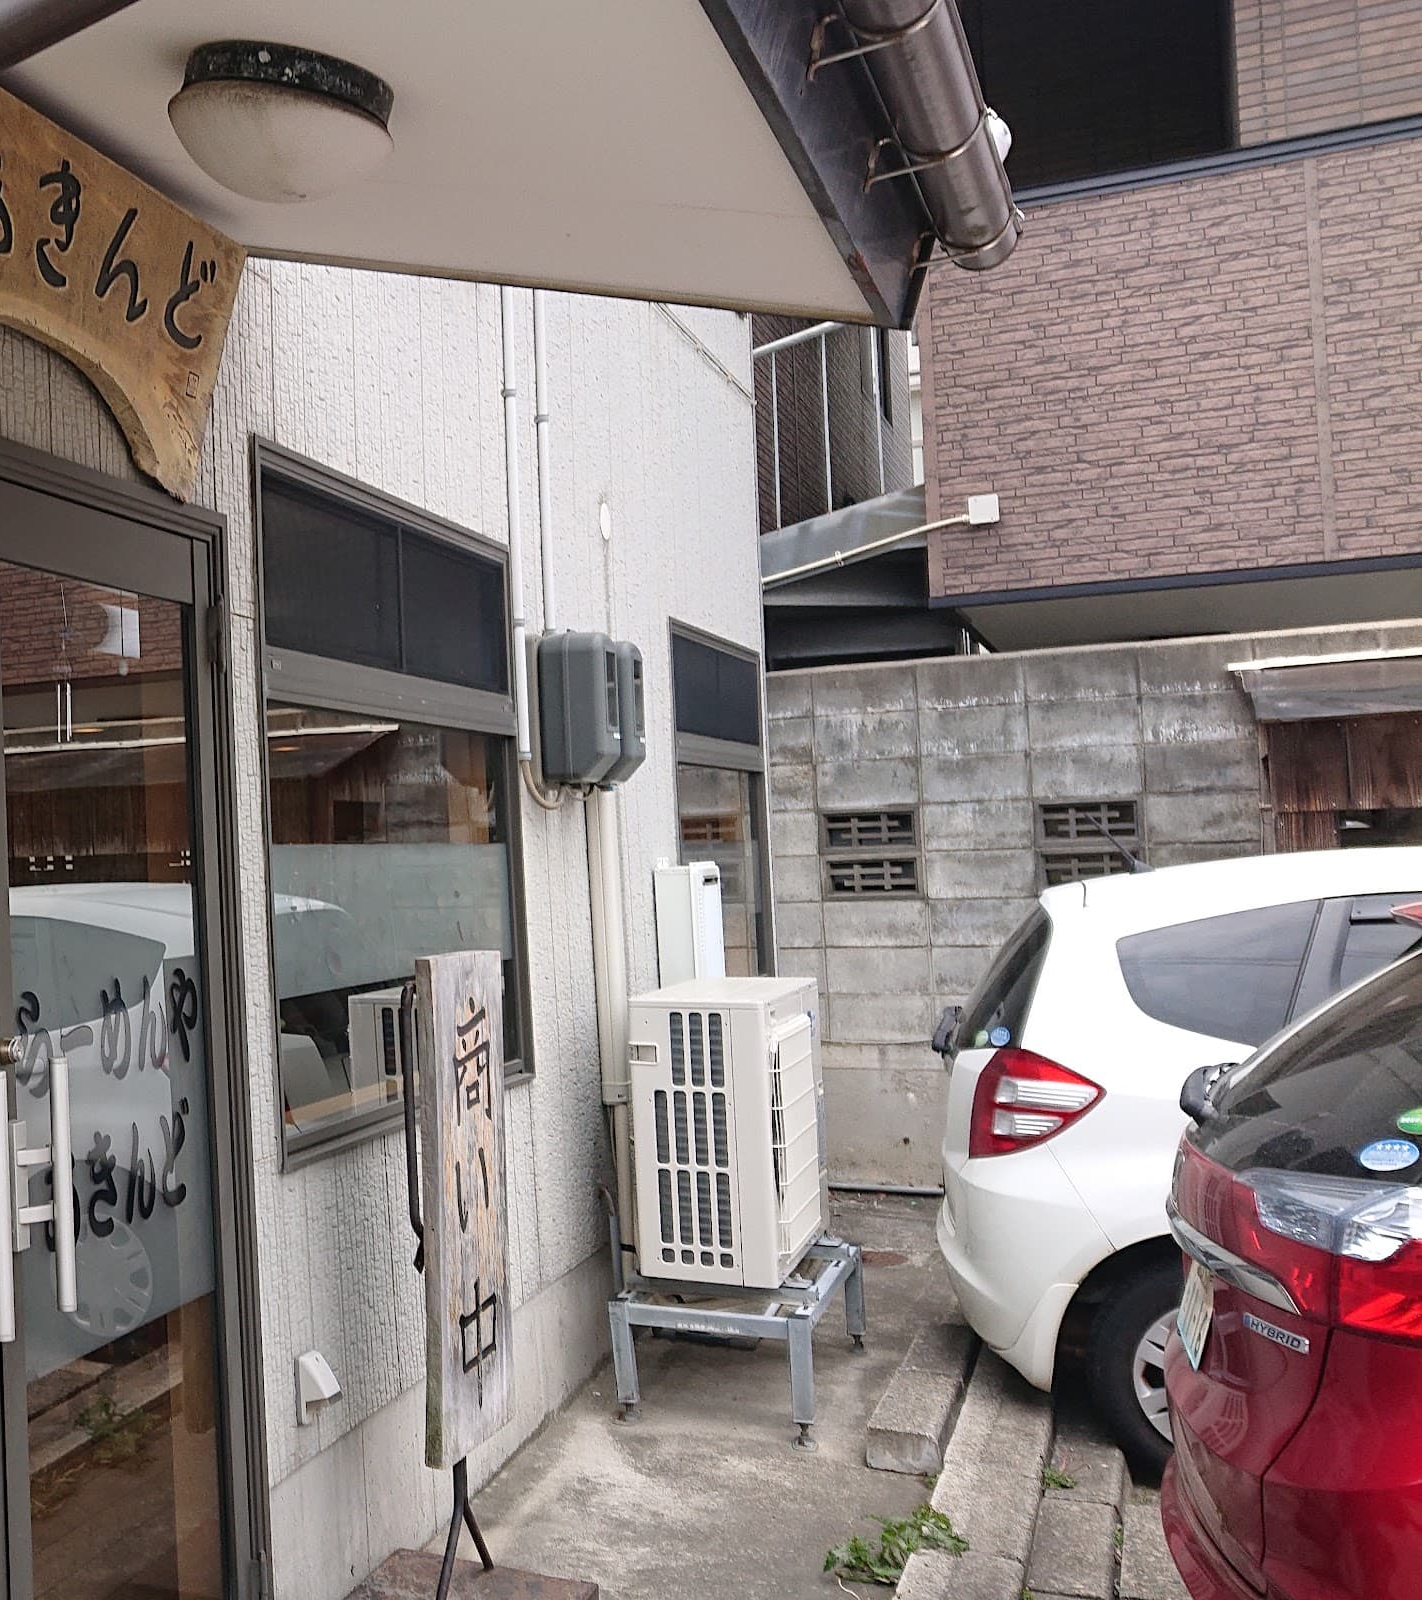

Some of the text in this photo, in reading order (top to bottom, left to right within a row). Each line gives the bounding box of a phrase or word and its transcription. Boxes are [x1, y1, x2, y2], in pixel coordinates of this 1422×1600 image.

[453, 996, 498, 1407] 商い中
[1249, 1318, 1302, 1350] HYBRID
